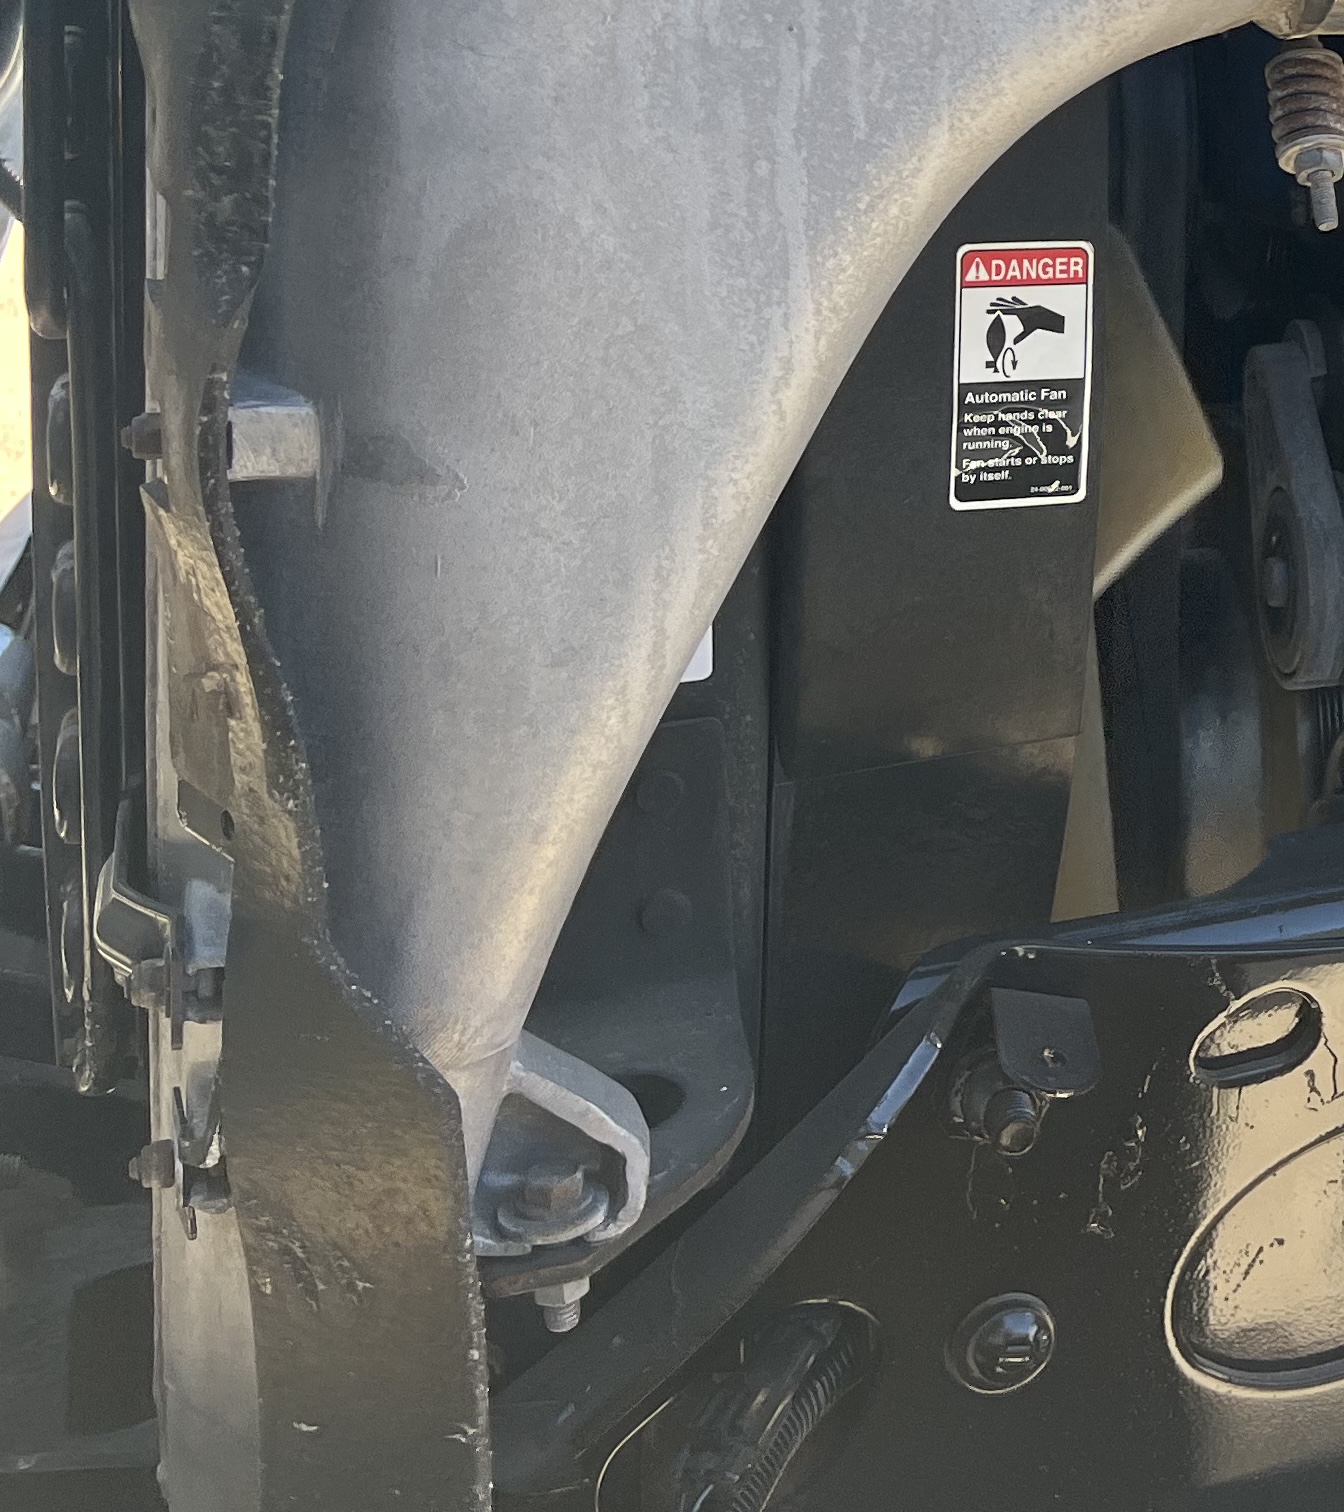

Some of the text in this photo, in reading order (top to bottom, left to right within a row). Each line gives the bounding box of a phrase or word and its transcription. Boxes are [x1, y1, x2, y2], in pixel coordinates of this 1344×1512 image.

[991, 257, 1083, 280] DANGER
[964, 388, 1067, 404] Automatic Fan
[964, 412, 995, 424] Keep
[998, 410, 1035, 422] hands
[963, 422, 1053, 437] when engine is
[962, 438, 1013, 451] running.
[1024, 456, 1038, 465] or
[1040, 454, 1075, 466] stops
[961, 469, 1013, 485] by itself.
